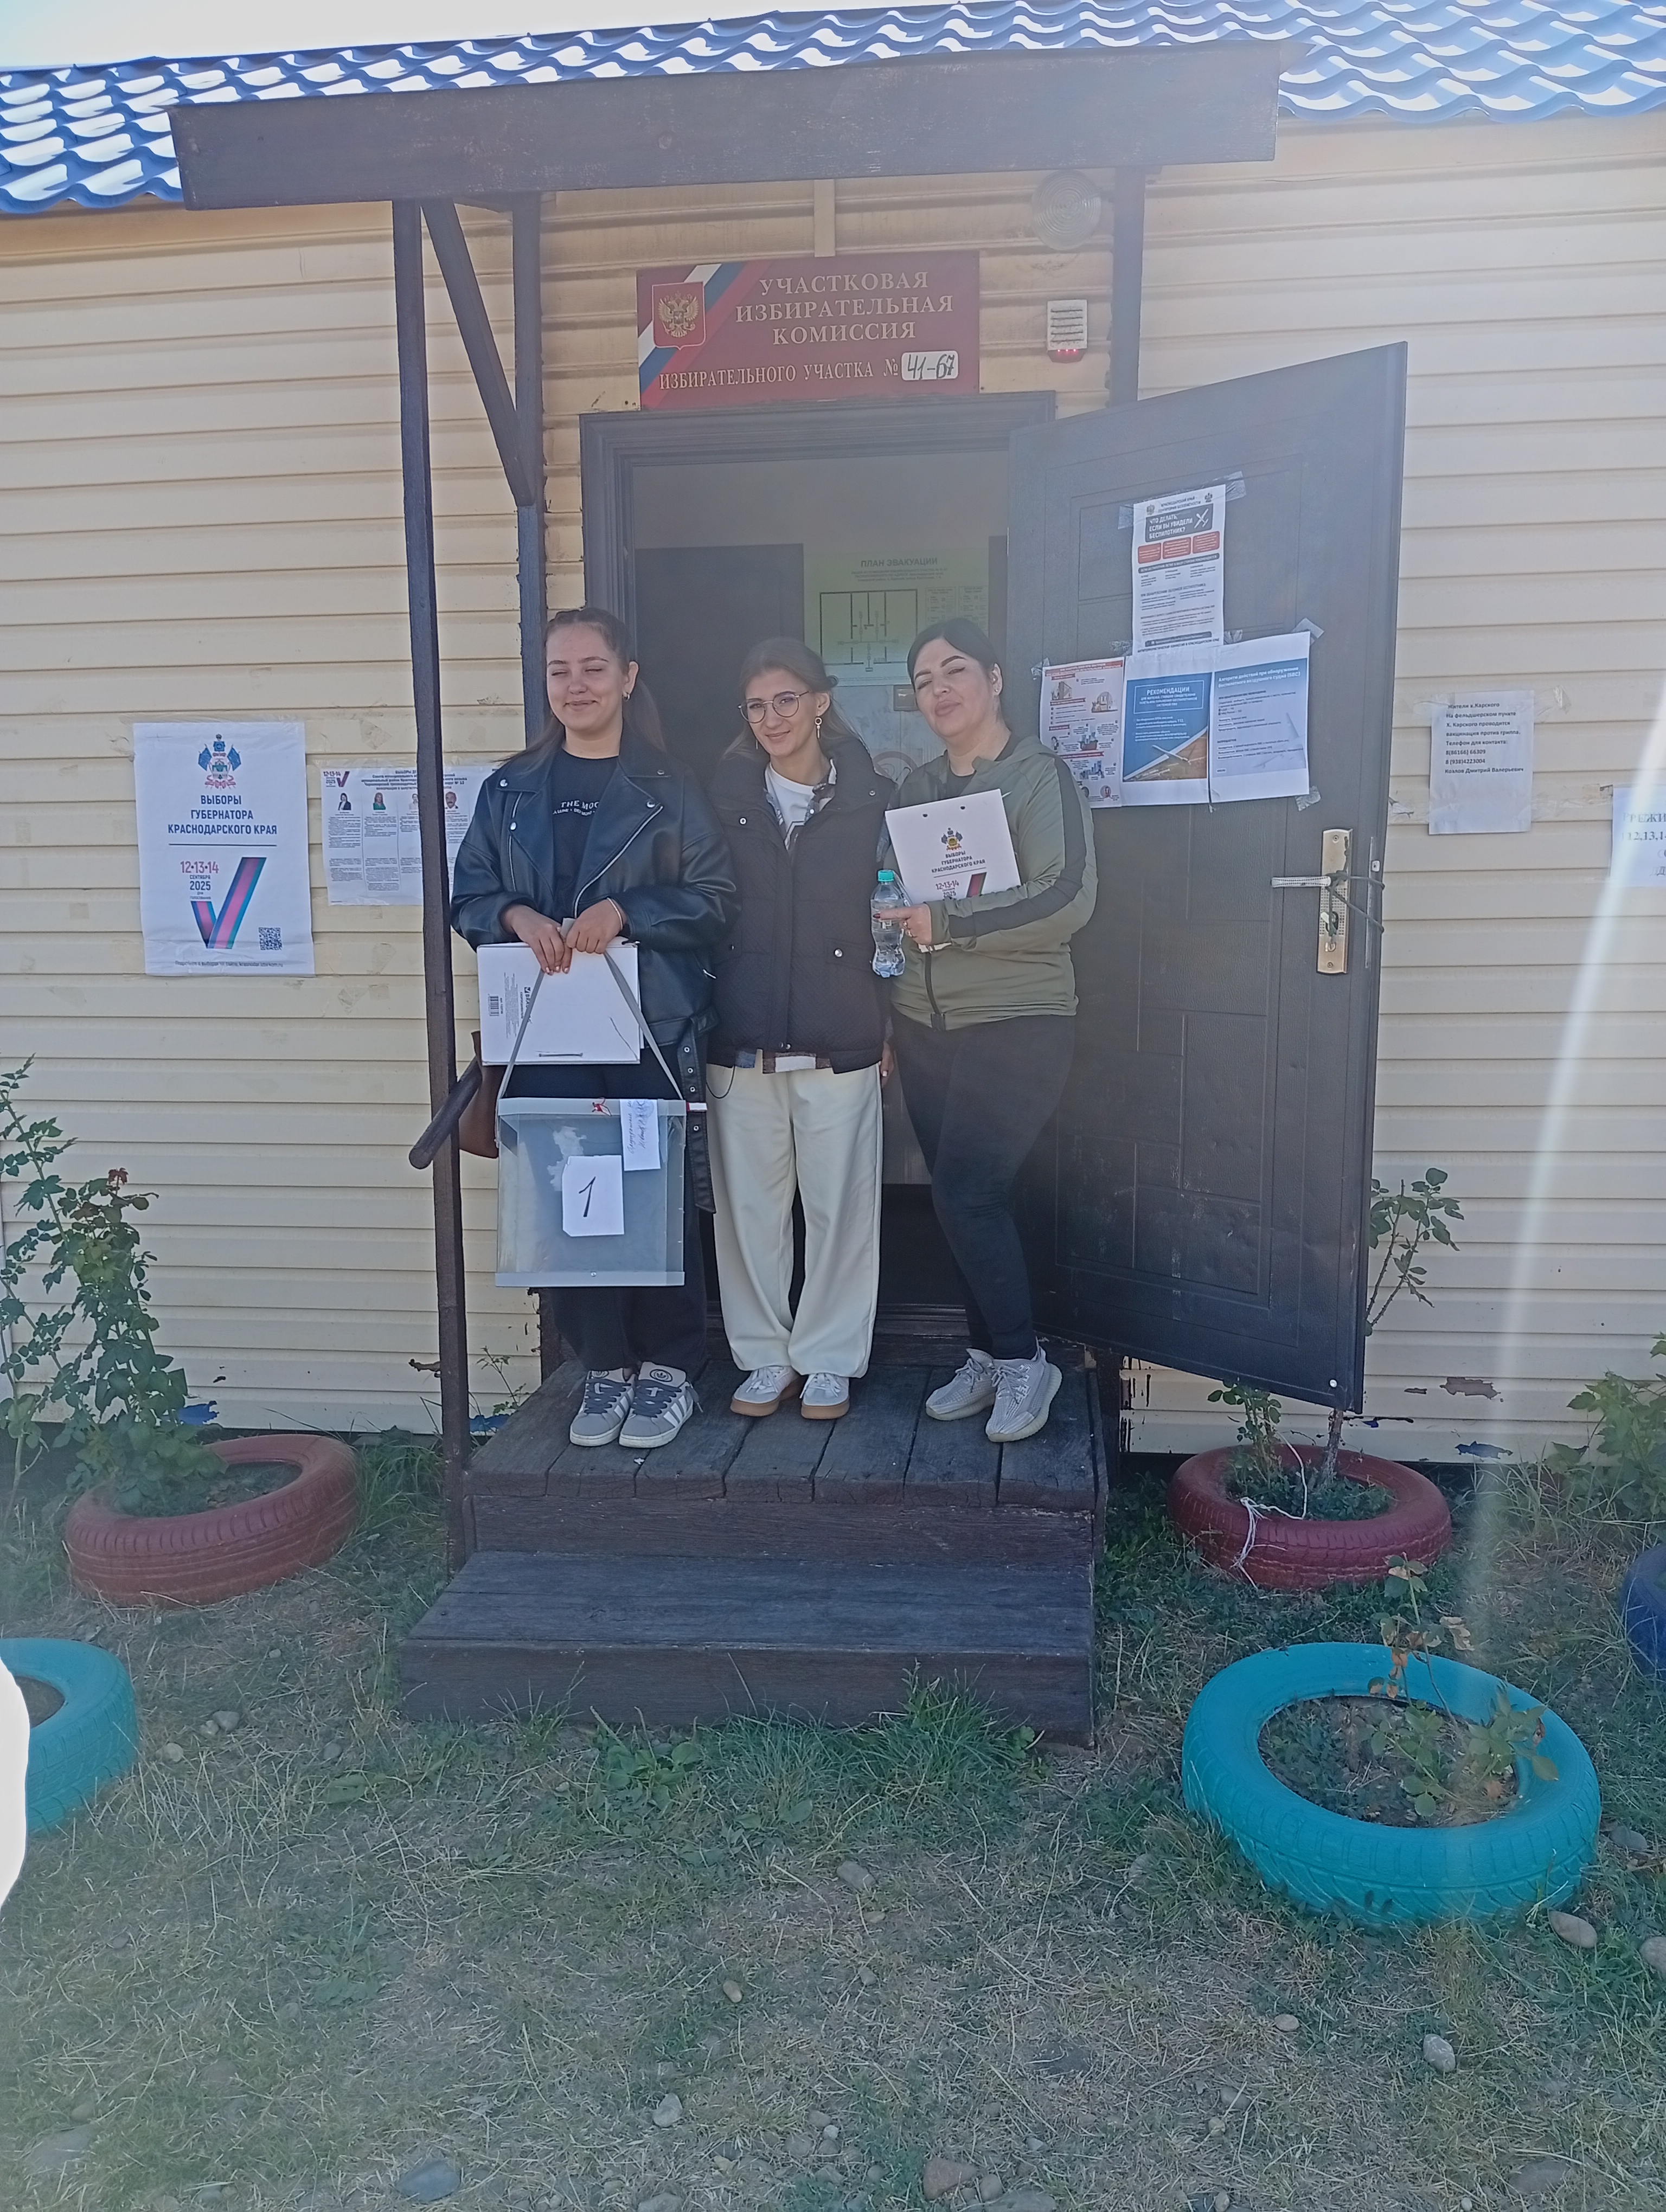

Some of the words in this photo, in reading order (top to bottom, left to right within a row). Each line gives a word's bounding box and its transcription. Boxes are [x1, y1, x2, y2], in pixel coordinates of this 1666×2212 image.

[759, 272, 929, 295] УЧАСТКОВАЯ
[735, 295, 953, 323] ИЗБИРАТЕЛЬНАЯ
[772, 321, 916, 345] КОМИССИЯ
[659, 365, 796, 389] ИЗБИРАТЕЛЬНОГО
[804, 361, 874, 380] УЧАСТКА
[883, 358, 899, 376] №
[907, 353, 955, 380] 41-67
[1170, 518, 1193, 528] УВИДЕЛИ
[1149, 527, 1186, 539] БЕСПИЛОТНИК?
[887, 557, 938, 566] ЭВАКУАЦИИ
[1146, 686, 1190, 696] РЕКОМЕНДАЦИИ
[201, 795, 242, 805] ВЫБОРЫ
[191, 809, 254, 819] ГУБЕРНАТОРА
[168, 824, 252, 835] КРАСНОДАРСКОГО
[254, 825, 277, 834] КРАЯ
[945, 850, 966, 858] ВЫБОРЫ
[941, 856, 973, 865] ГУБЕРНАТОРА
[931, 861, 973, 873] КРАСНОДАРСКОГО
[189, 880, 211, 891] 2025
[579, 1175, 597, 1218] 1
